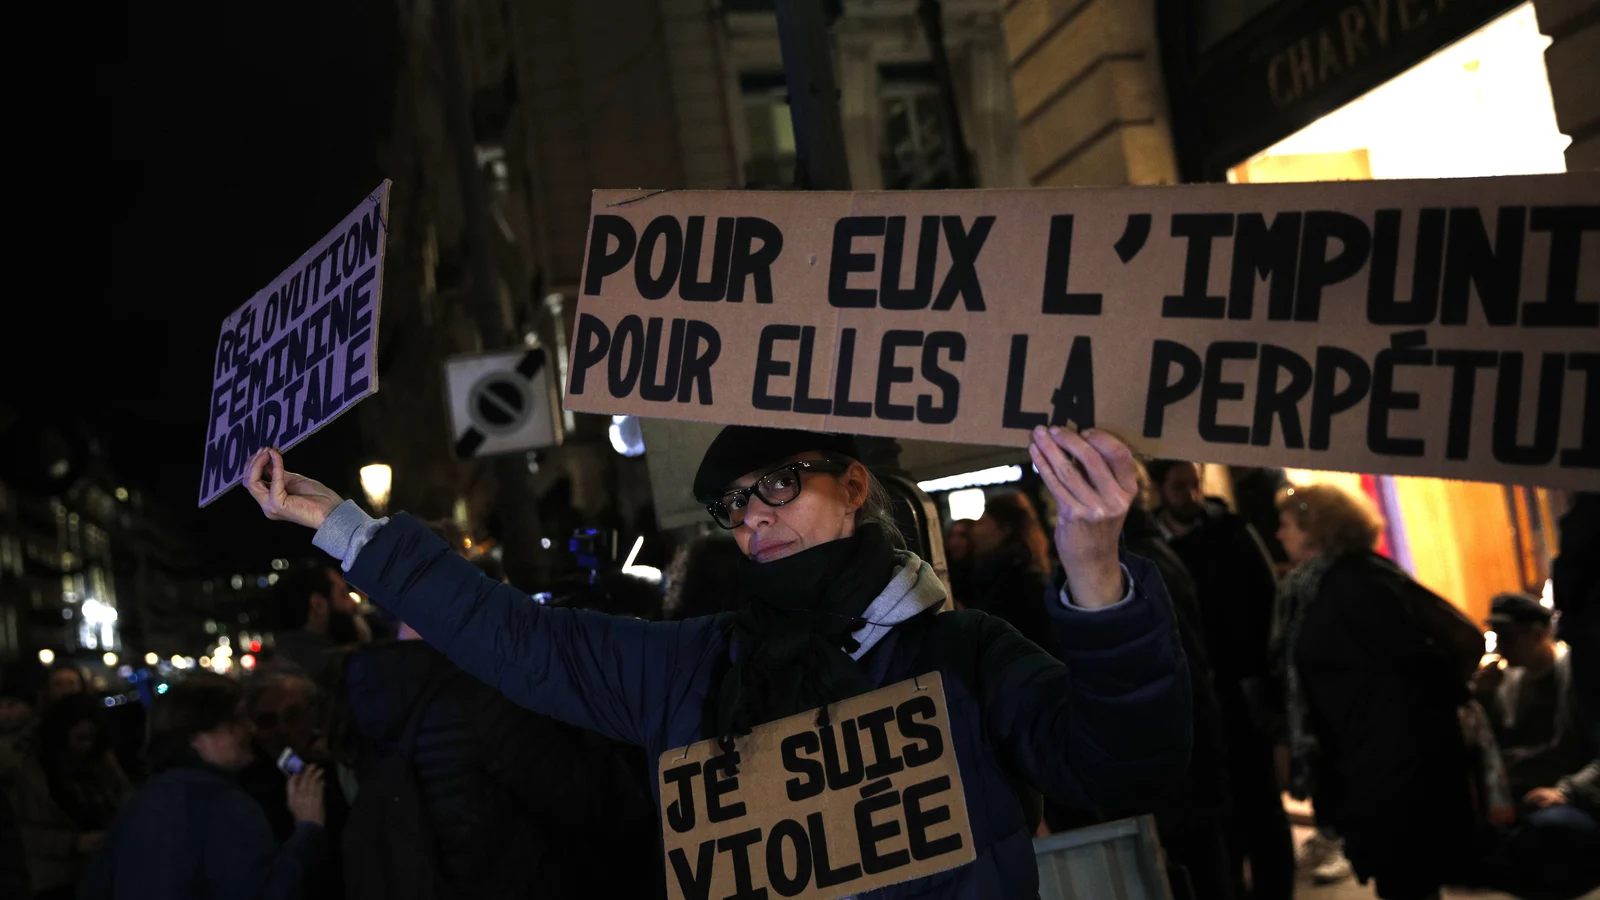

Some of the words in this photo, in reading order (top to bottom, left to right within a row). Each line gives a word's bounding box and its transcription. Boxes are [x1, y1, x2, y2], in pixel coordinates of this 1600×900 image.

[1267, 0, 1448, 108] CHARVE
[584, 214, 783, 304] POUR
[828, 215, 996, 312] EUX
[201, 327, 371, 501] MONDIALE
[569, 313, 721, 405] POUR
[752, 324, 966, 425] ELLES
[1003, 334, 1095, 430] LA
[663, 750, 747, 833] JE
[781, 695, 944, 802] SUIS
[668, 774, 963, 900] VIOLÉE
